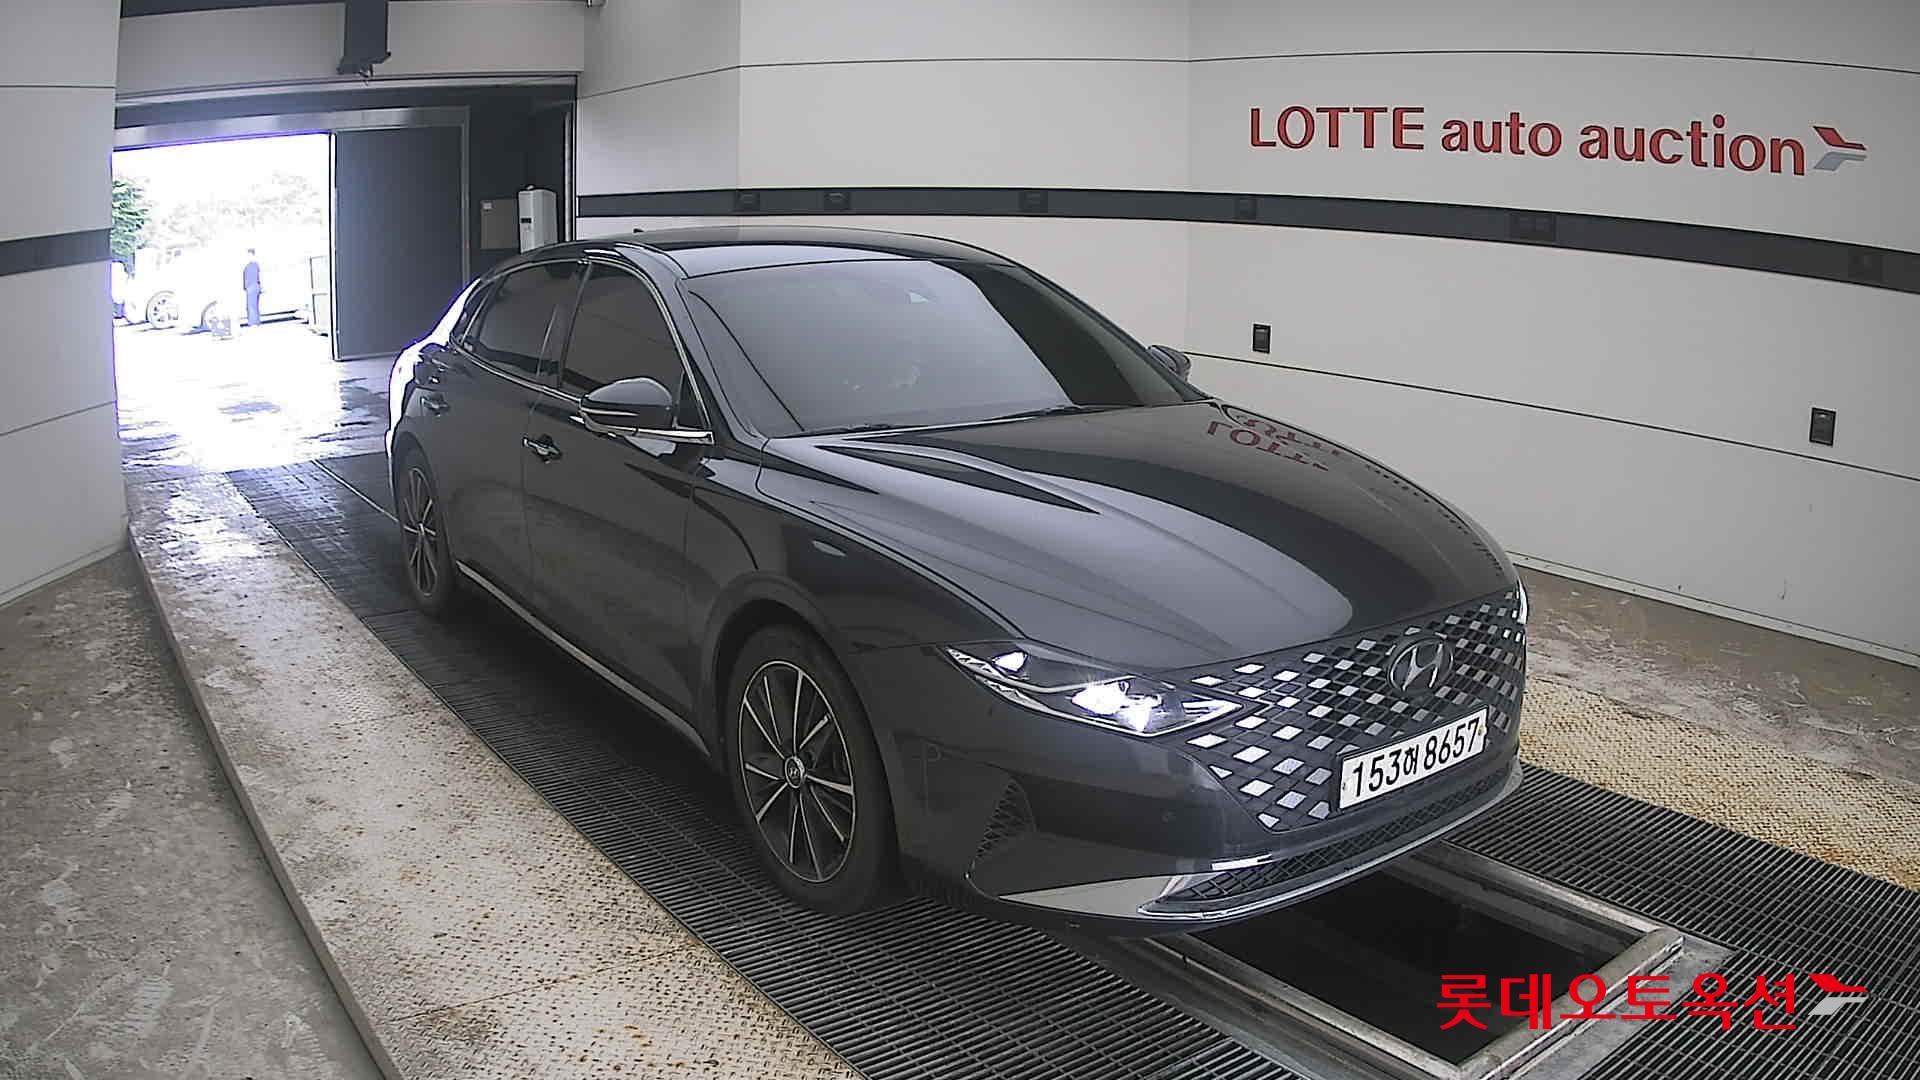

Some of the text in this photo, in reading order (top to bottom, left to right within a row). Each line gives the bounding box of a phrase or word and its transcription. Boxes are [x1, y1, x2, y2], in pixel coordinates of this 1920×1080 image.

[1250, 106, 1805, 176] LOTTE auto auction
